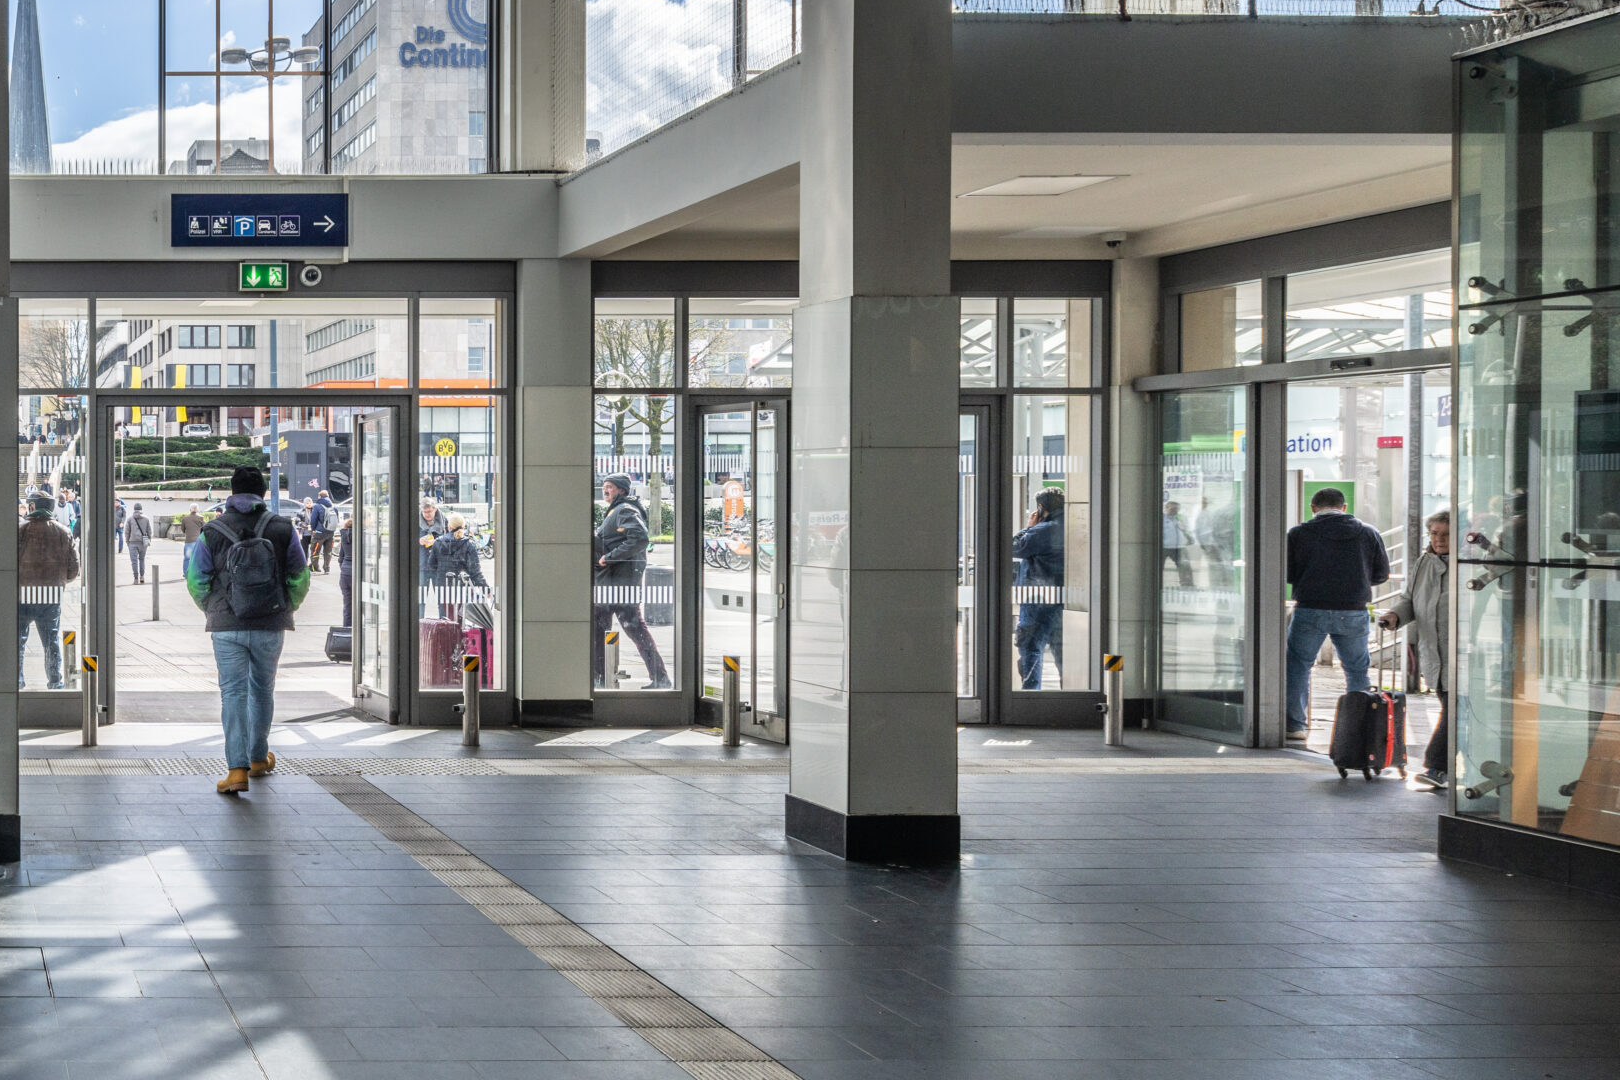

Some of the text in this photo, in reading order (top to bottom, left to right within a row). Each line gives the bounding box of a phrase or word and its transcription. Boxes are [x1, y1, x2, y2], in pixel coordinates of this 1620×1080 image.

[415, 26, 446, 44] Die
[398, 41, 487, 68] Contin
[438, 440, 454, 453] BVB
[1286, 433, 1332, 454] ation
